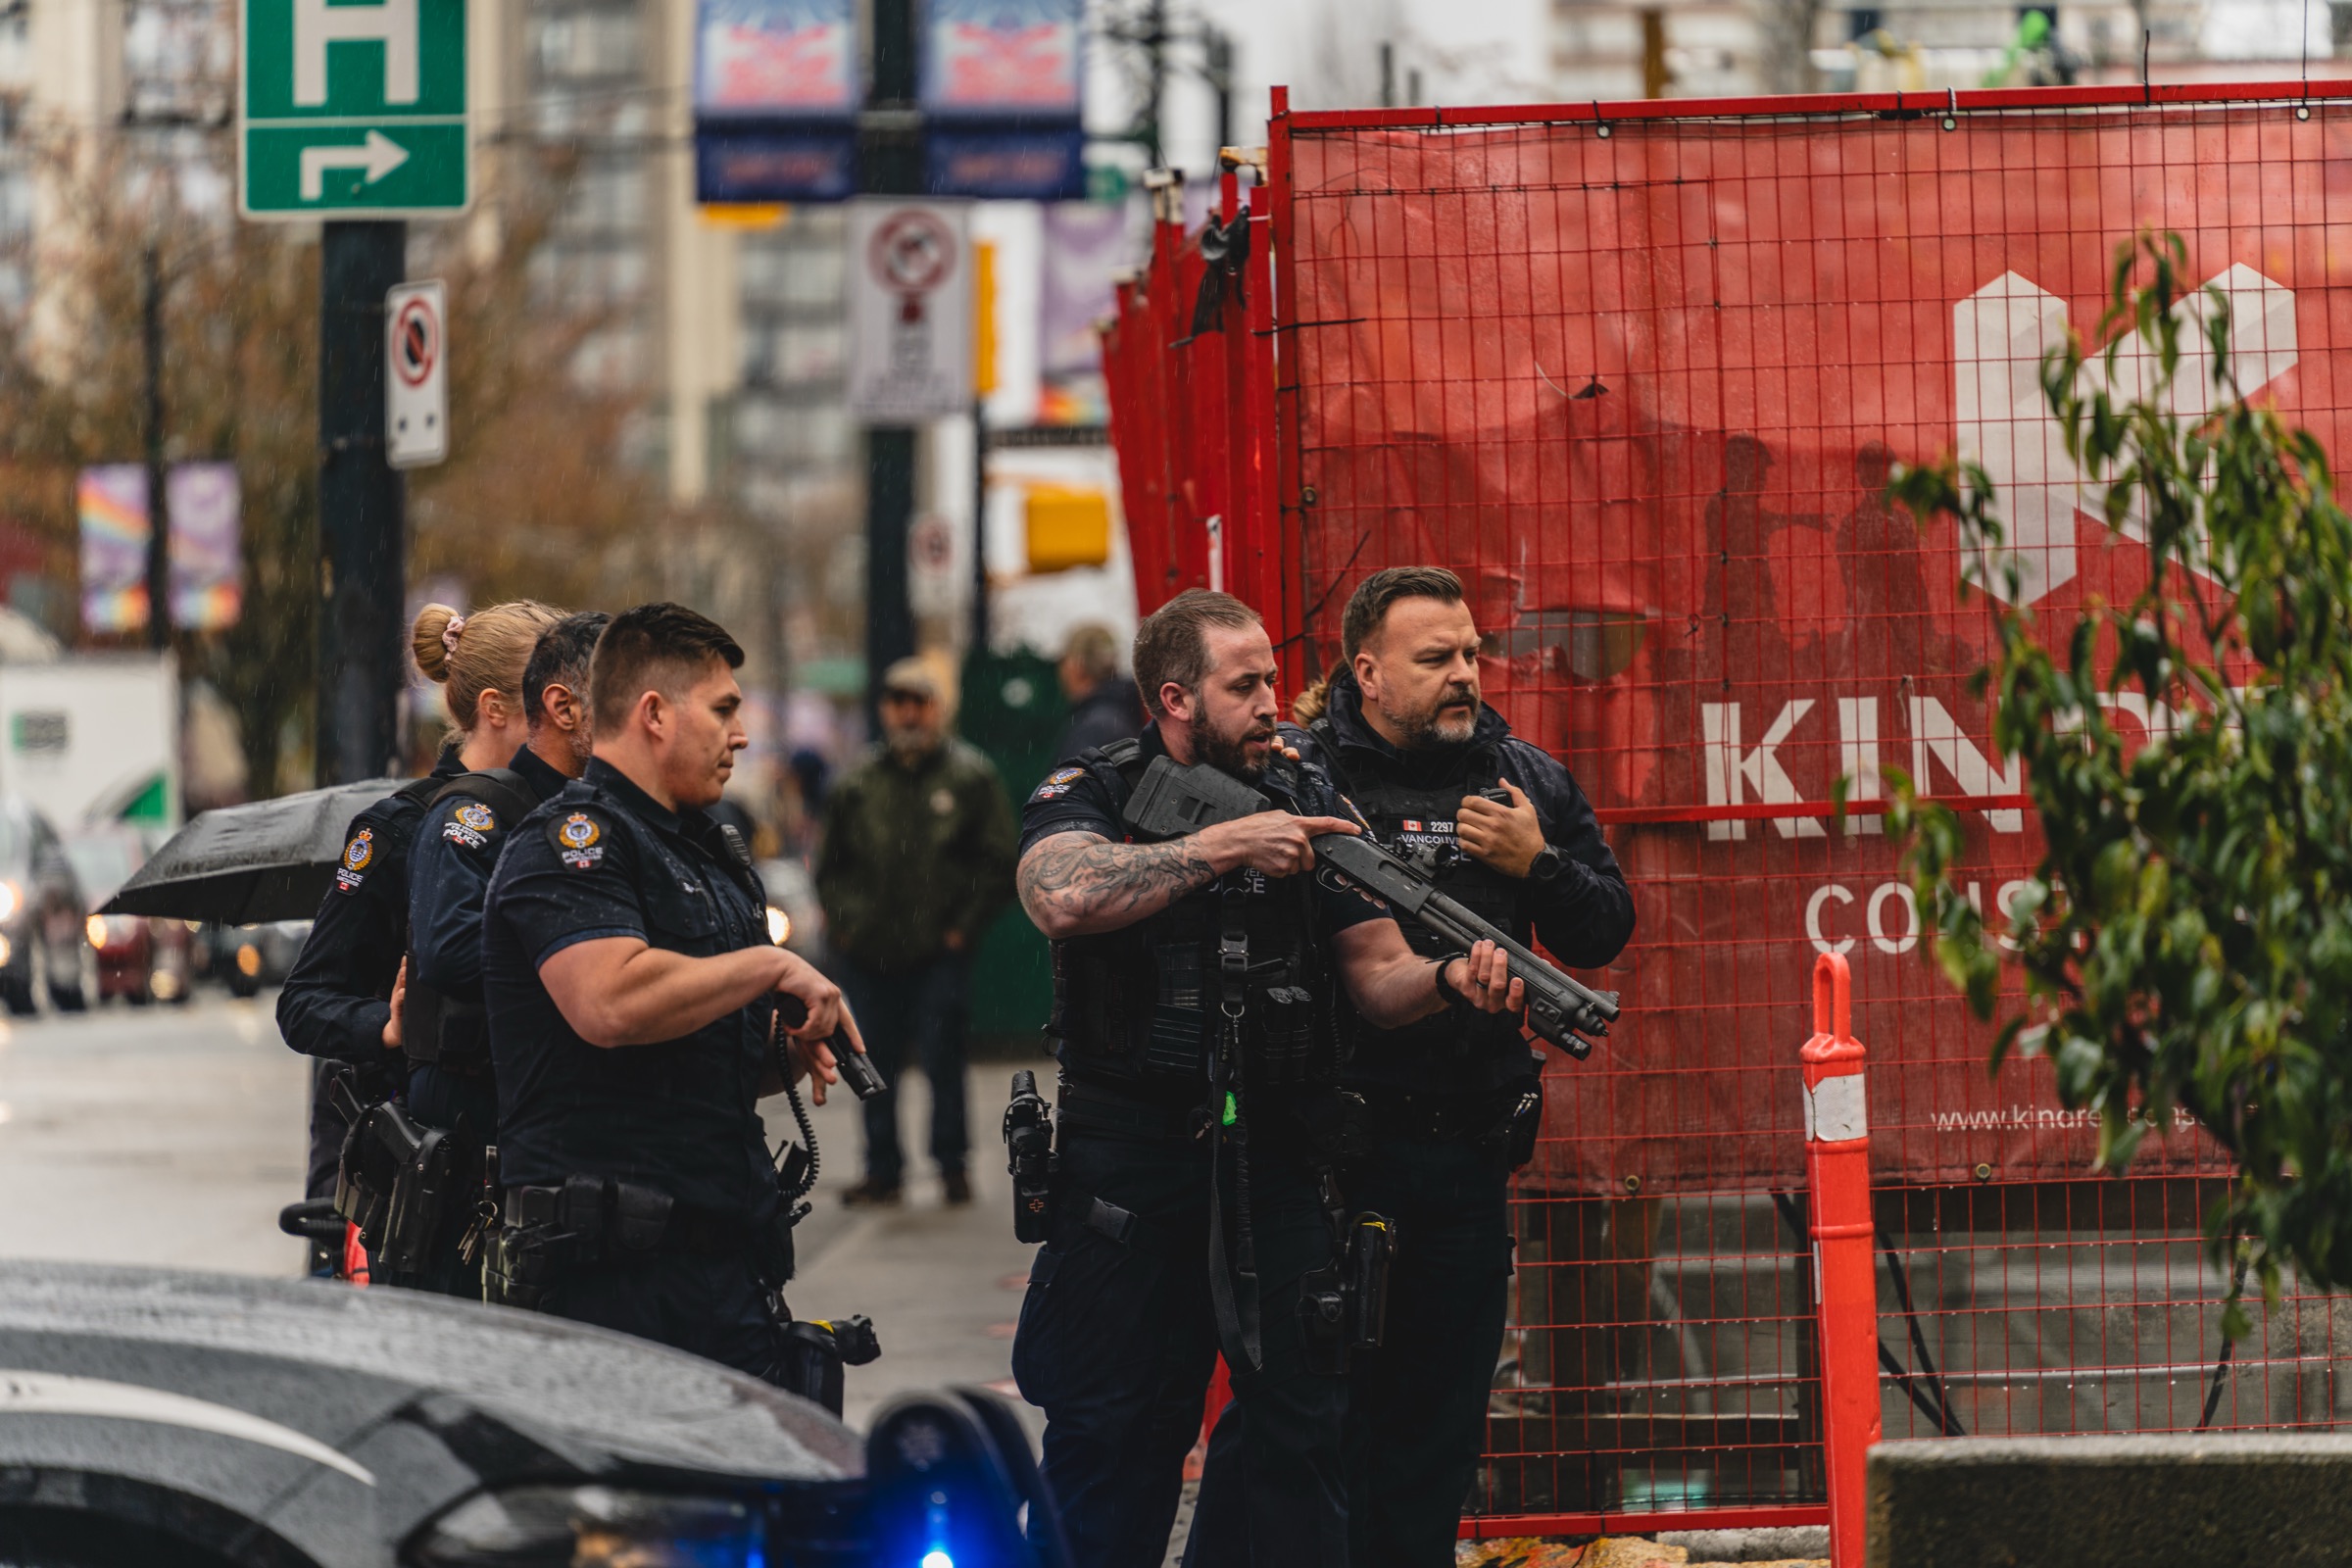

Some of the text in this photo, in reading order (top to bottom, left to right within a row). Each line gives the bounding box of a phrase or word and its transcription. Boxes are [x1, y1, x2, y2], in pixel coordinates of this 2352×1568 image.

[293, 0, 418, 107] H
[1431, 821, 1453, 833] 2297
[443, 828, 480, 850] POLICE
[562, 847, 603, 859] POLICE
[336, 867, 364, 883] POLICE
[1805, 880, 2081, 955] COS
